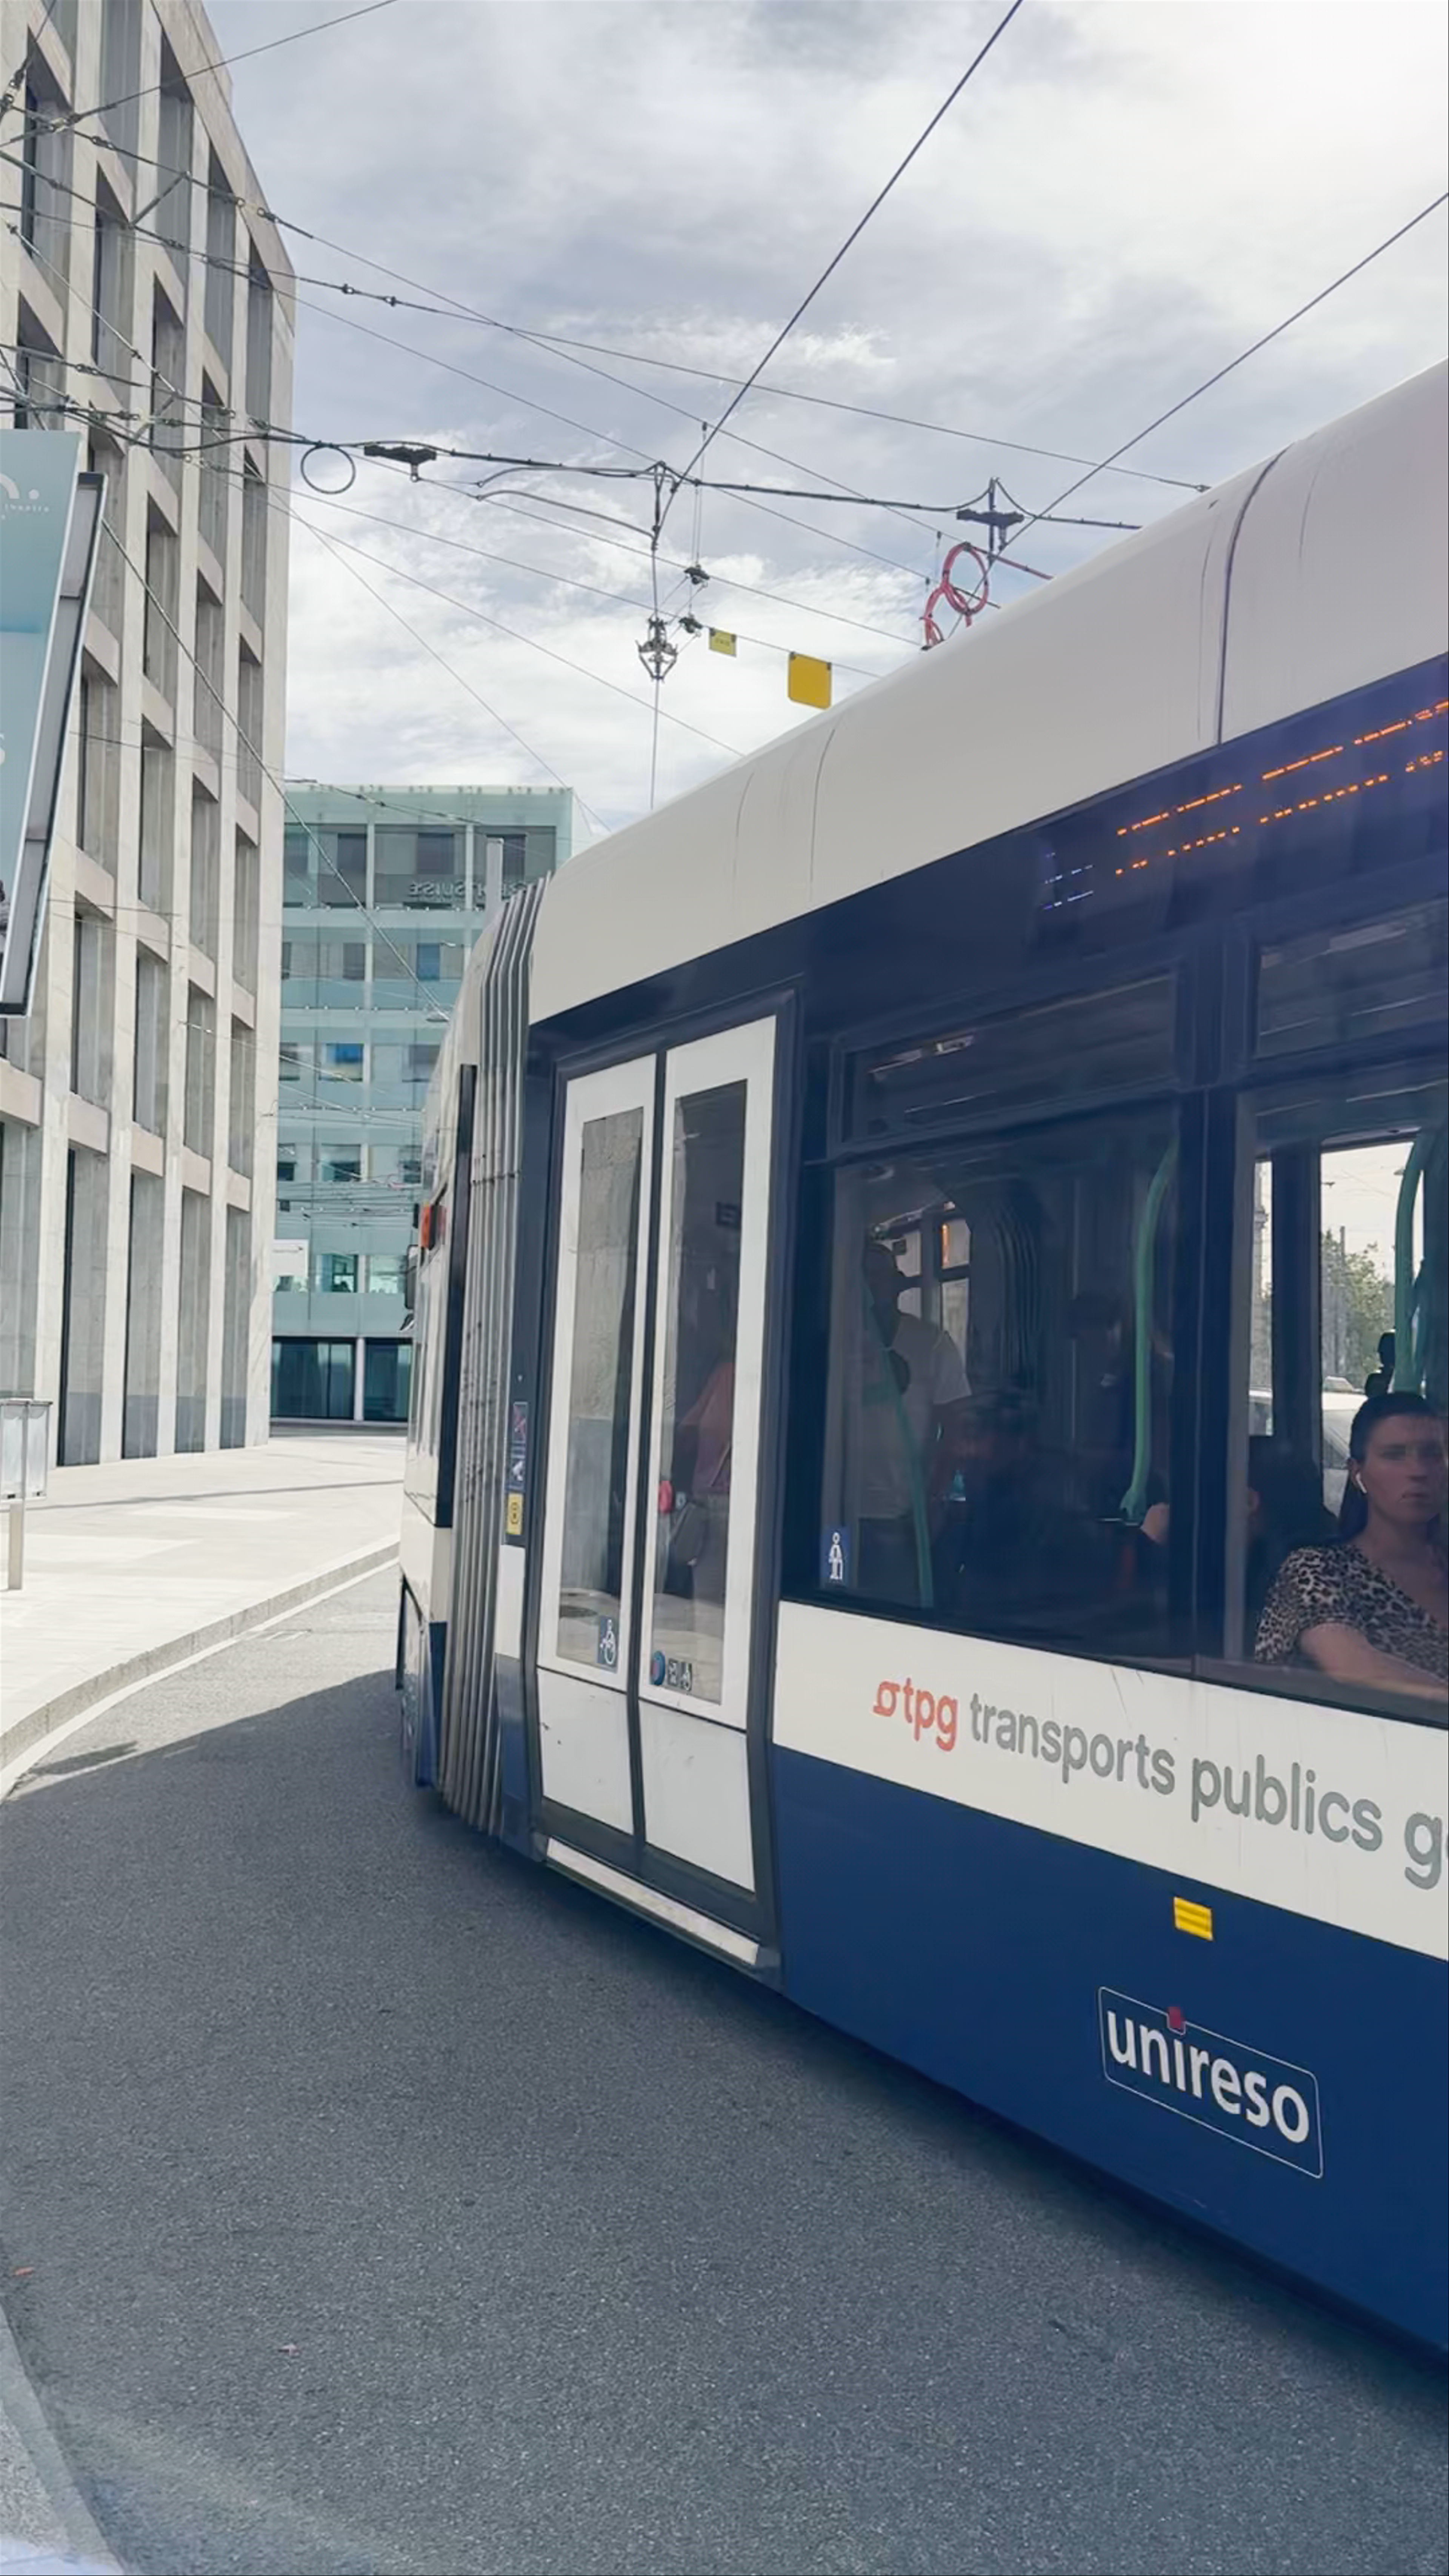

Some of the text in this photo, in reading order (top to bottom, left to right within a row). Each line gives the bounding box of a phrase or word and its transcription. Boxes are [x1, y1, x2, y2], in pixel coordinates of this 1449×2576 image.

[970, 1693, 1175, 1795] transports
[1191, 1754, 1383, 1851] publics
[1404, 1812, 1448, 1890] g
[1107, 2007, 1309, 2142] unireso
